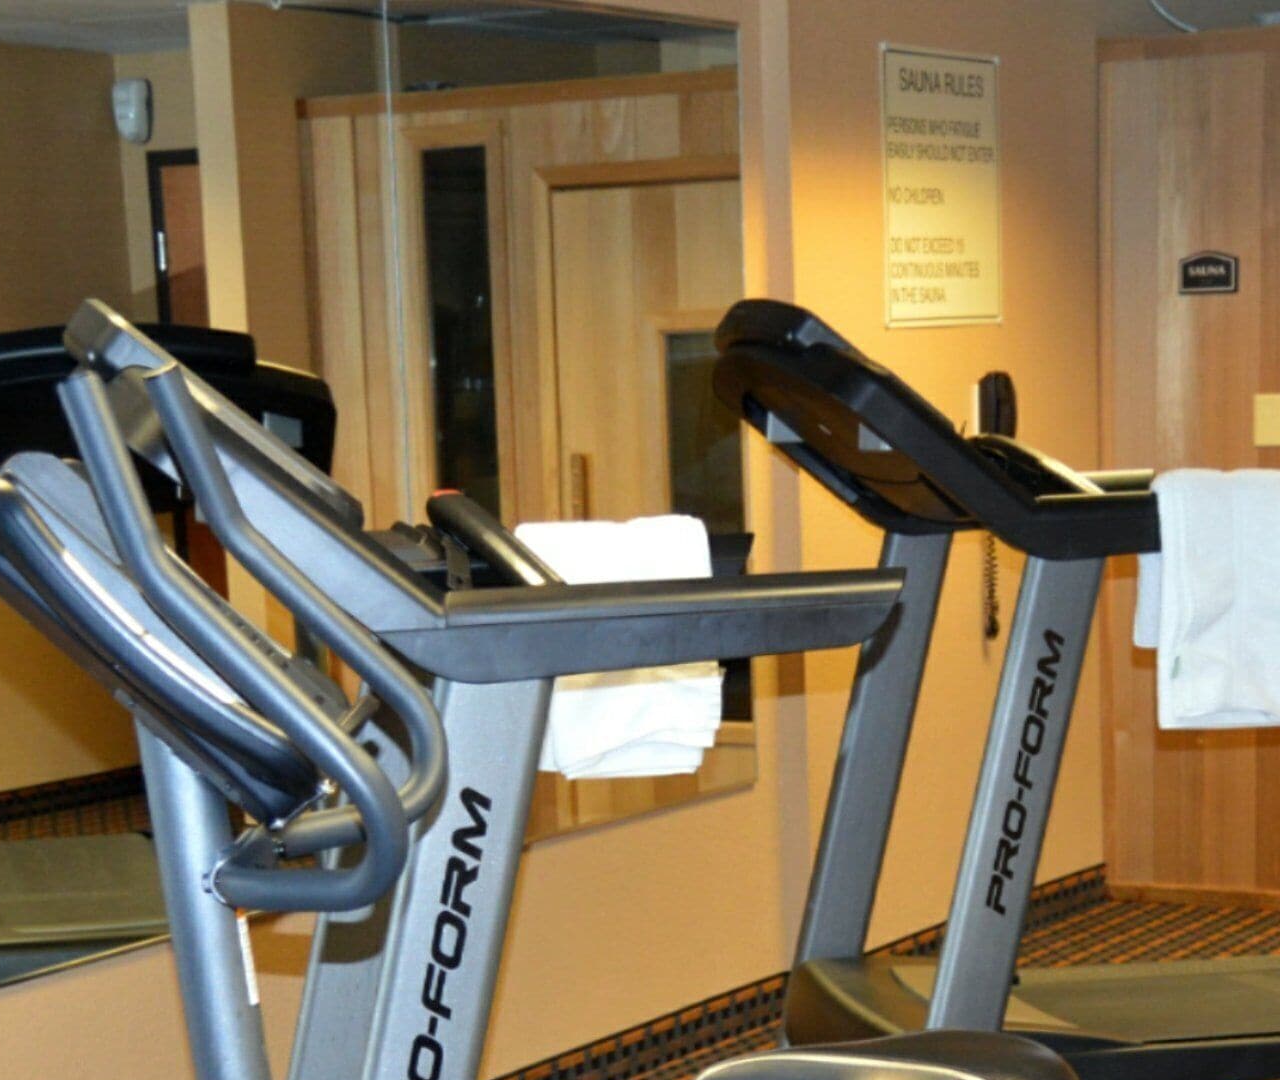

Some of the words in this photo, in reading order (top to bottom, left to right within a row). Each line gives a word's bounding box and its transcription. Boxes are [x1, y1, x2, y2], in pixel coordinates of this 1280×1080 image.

[899, 66, 941, 93] SAUNA
[944, 72, 984, 98] RULES
[888, 186, 902, 204] NO
[890, 237, 902, 254] DO
[986, 628, 1065, 916] PRO-FORM
